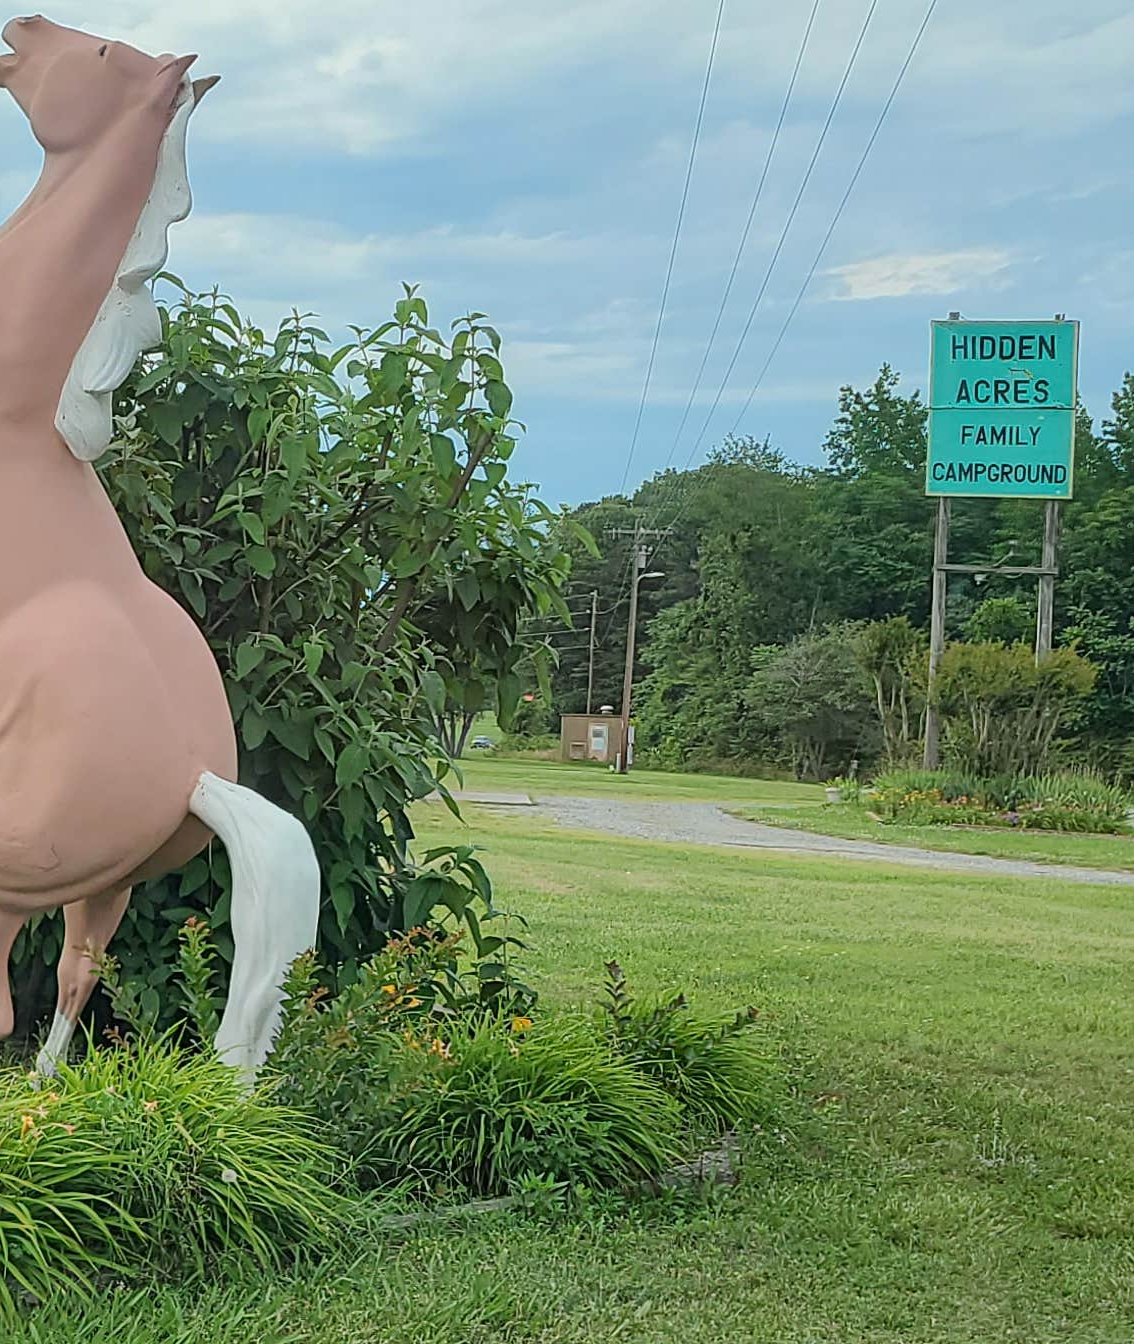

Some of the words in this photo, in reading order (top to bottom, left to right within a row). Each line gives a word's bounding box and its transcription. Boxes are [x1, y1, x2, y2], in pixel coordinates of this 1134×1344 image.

[951, 335, 1056, 360] HIDDEN
[956, 379, 1050, 404] ACRES
[961, 425, 1041, 446] FAMILY
[932, 462, 1067, 484] CAMPGROUND
